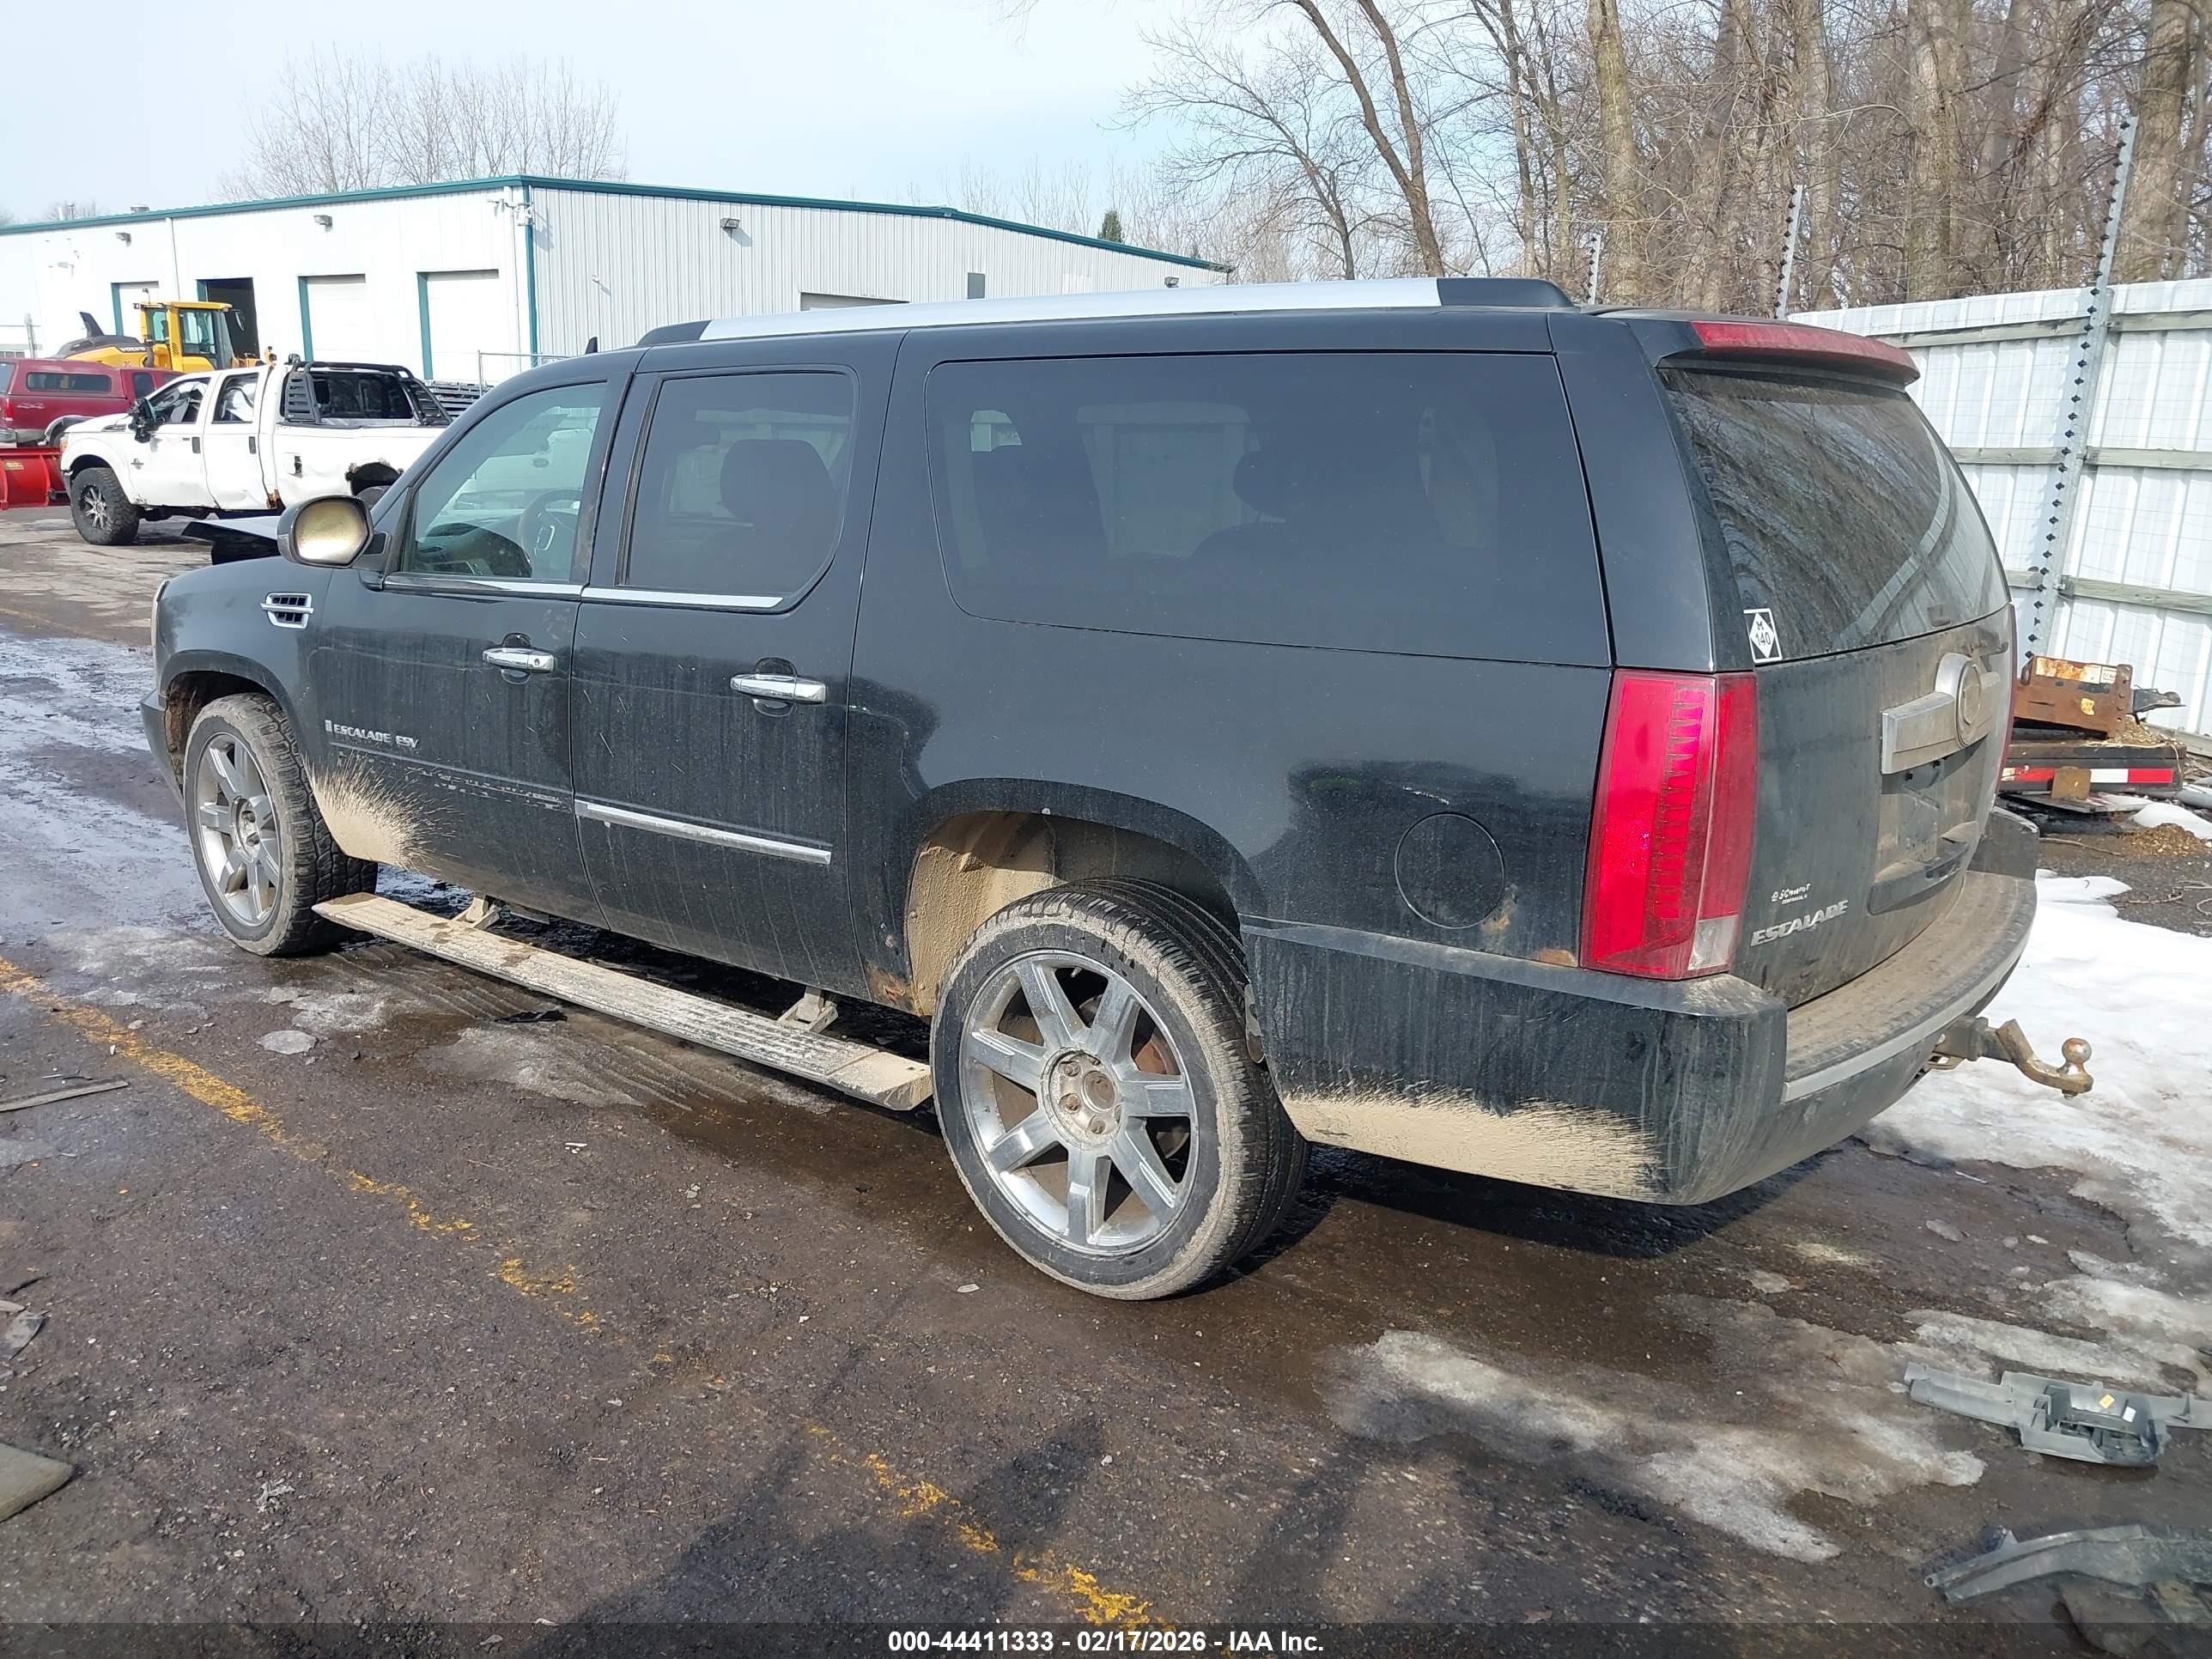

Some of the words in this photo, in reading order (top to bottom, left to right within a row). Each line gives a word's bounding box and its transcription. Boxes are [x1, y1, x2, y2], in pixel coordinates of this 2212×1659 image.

[1756, 621, 1765, 630] M
[1754, 631, 1771, 647] 140
[333, 723, 392, 743] ESCALADE
[395, 734, 419, 748] ESV
[1750, 899, 1849, 948] ESCALADE
